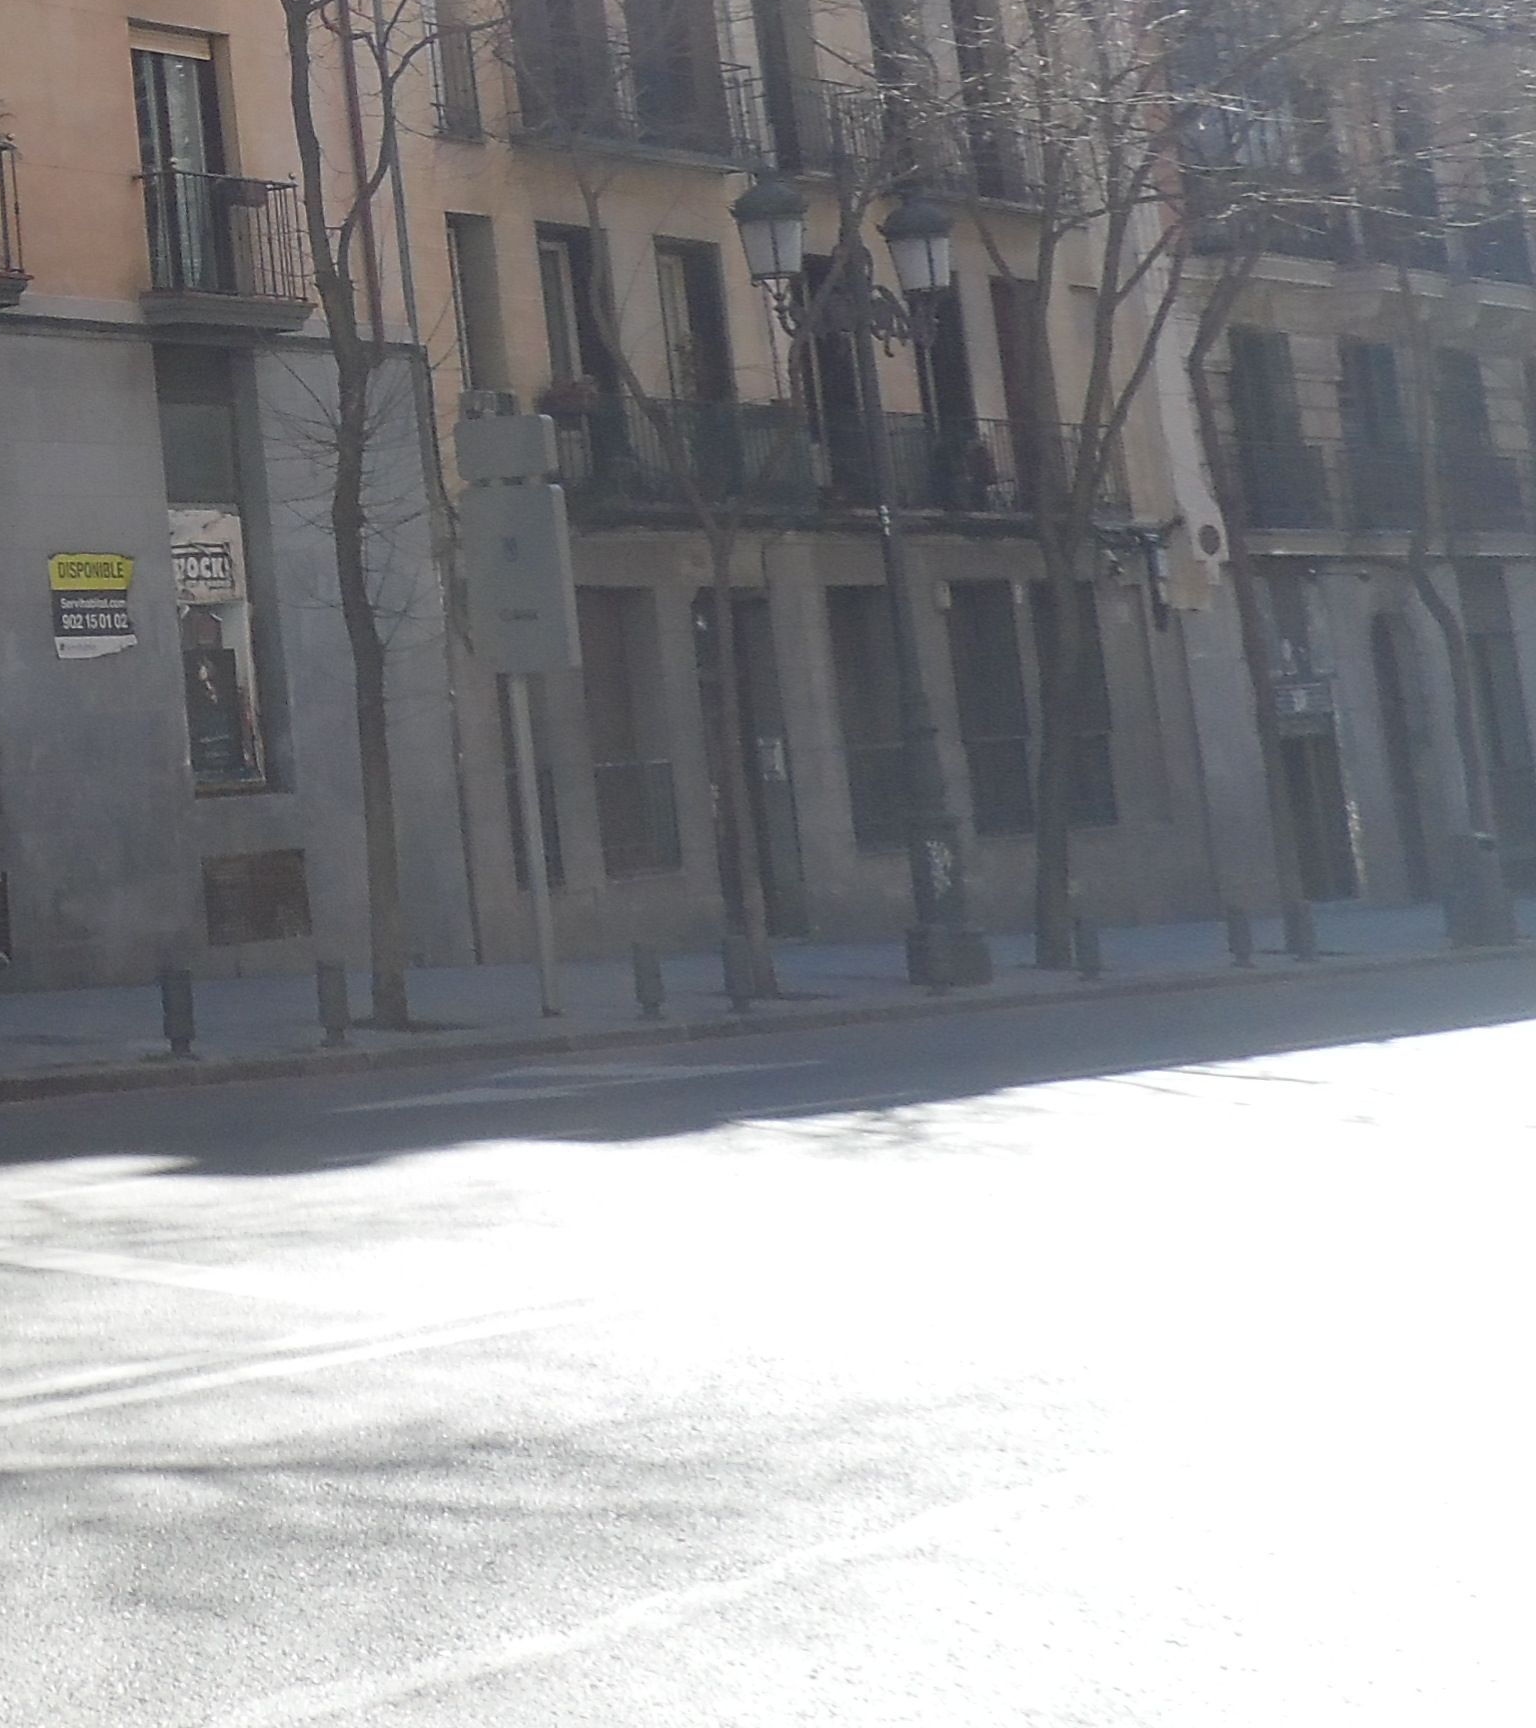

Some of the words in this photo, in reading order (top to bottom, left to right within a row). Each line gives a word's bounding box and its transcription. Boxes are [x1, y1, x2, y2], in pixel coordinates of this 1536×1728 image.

[58, 561, 125, 579] DISPONIBLE
[62, 614, 84, 629] 902
[85, 614, 98, 628] 15
[99, 613, 113, 628] 01
[114, 613, 129, 628] 02
